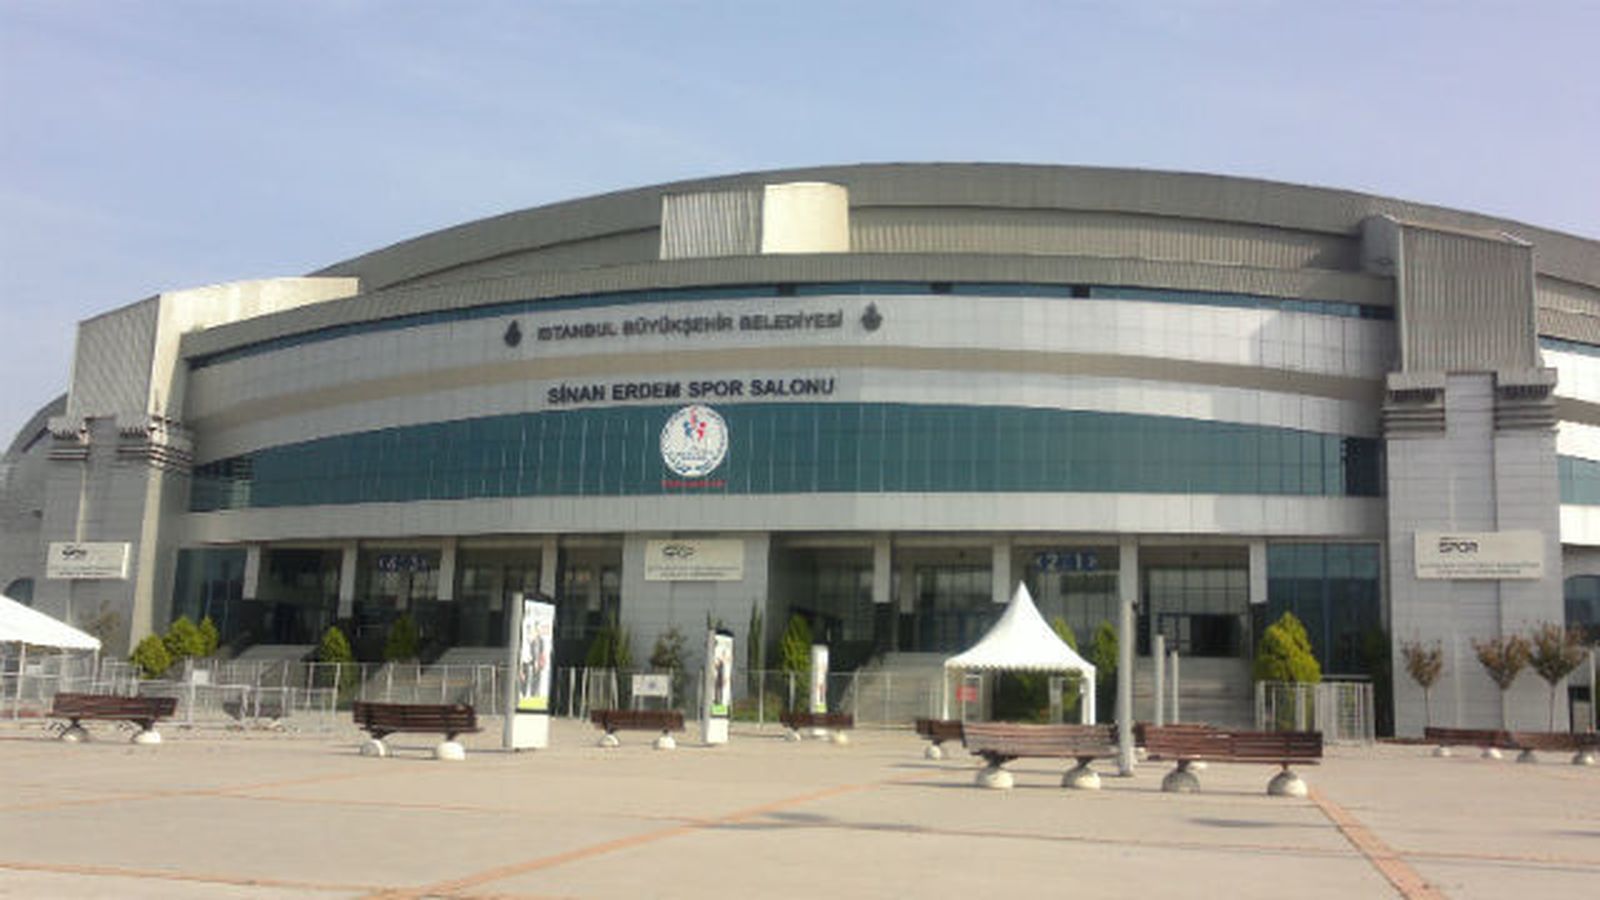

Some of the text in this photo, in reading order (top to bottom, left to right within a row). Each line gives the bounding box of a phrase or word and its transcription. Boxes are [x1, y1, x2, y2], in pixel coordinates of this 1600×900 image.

[547, 378, 835, 404] SİNAN ERDEM SPOR SALONU
